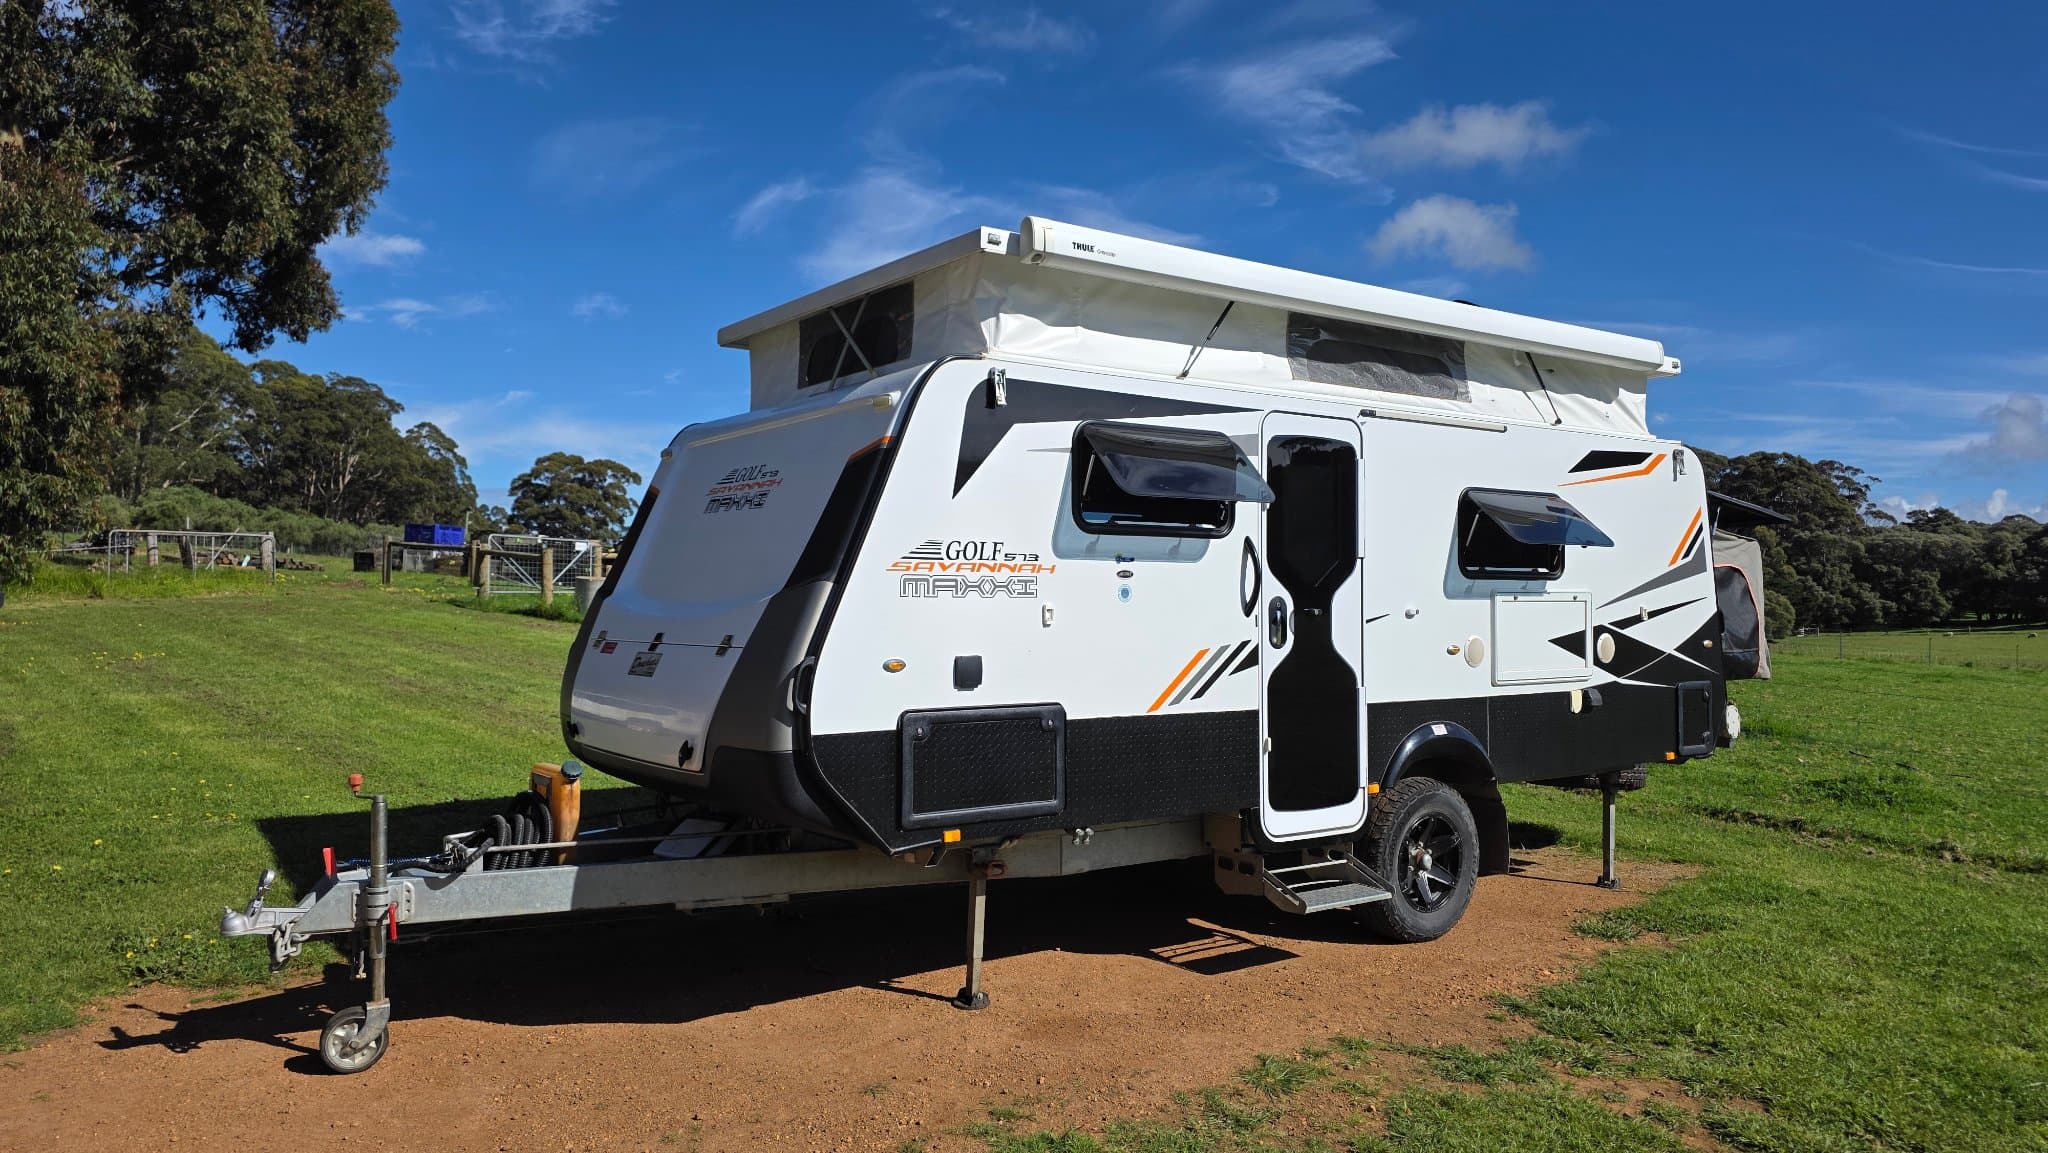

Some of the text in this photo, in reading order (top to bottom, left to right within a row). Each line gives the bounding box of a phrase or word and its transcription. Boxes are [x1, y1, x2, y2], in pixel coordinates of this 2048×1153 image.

[1072, 241, 1095, 253] THULE
[735, 464, 767, 482] GOLF
[945, 540, 1040, 562] GOLF 573
[886, 561, 1057, 574] SAVANNAH
[900, 574, 1038, 598] MAXXI
